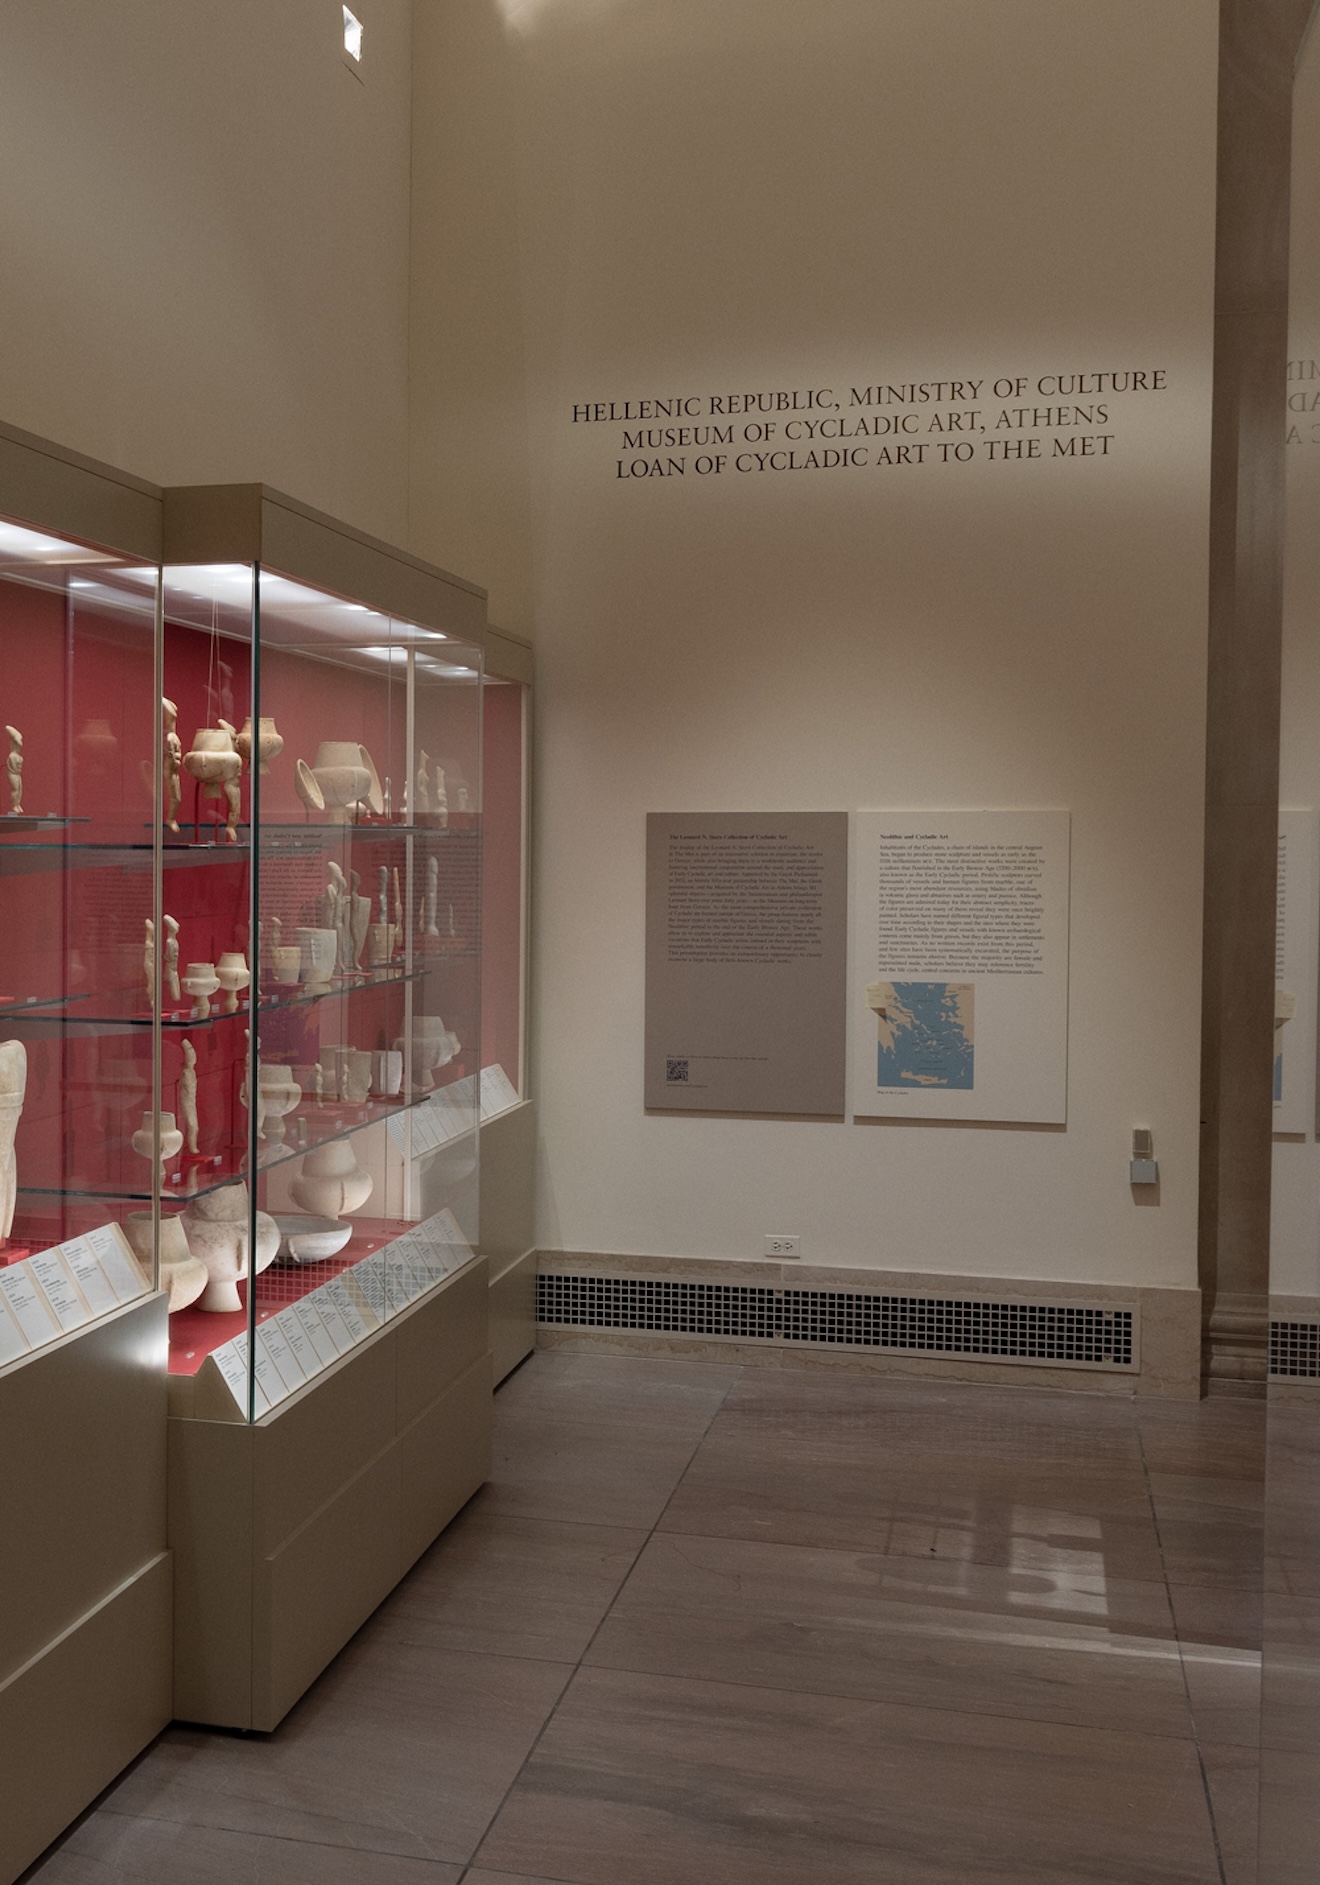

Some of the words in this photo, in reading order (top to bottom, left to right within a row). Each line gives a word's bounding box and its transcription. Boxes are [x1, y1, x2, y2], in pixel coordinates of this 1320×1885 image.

[572, 397, 700, 423] HELLENIC
[709, 389, 840, 415] REPUBLIC,
[849, 380, 983, 406] MINISTRY
[994, 378, 1028, 398] OF
[1038, 370, 1167, 396] CULTURE
[622, 425, 734, 449] MUSEUM
[744, 423, 776, 442] OF
[785, 415, 918, 440] CYCLADIC
[928, 411, 985, 434] ART,
[995, 404, 1108, 429] ATHENS
[616, 458, 685, 478] LOAN
[695, 455, 727, 474] OF
[735, 448, 868, 472] CYCLADIC
[876, 444, 929, 465] ART
[937, 442, 974, 462] TO
[983, 439, 1041, 460] THE
[1051, 435, 1114, 457] MET
